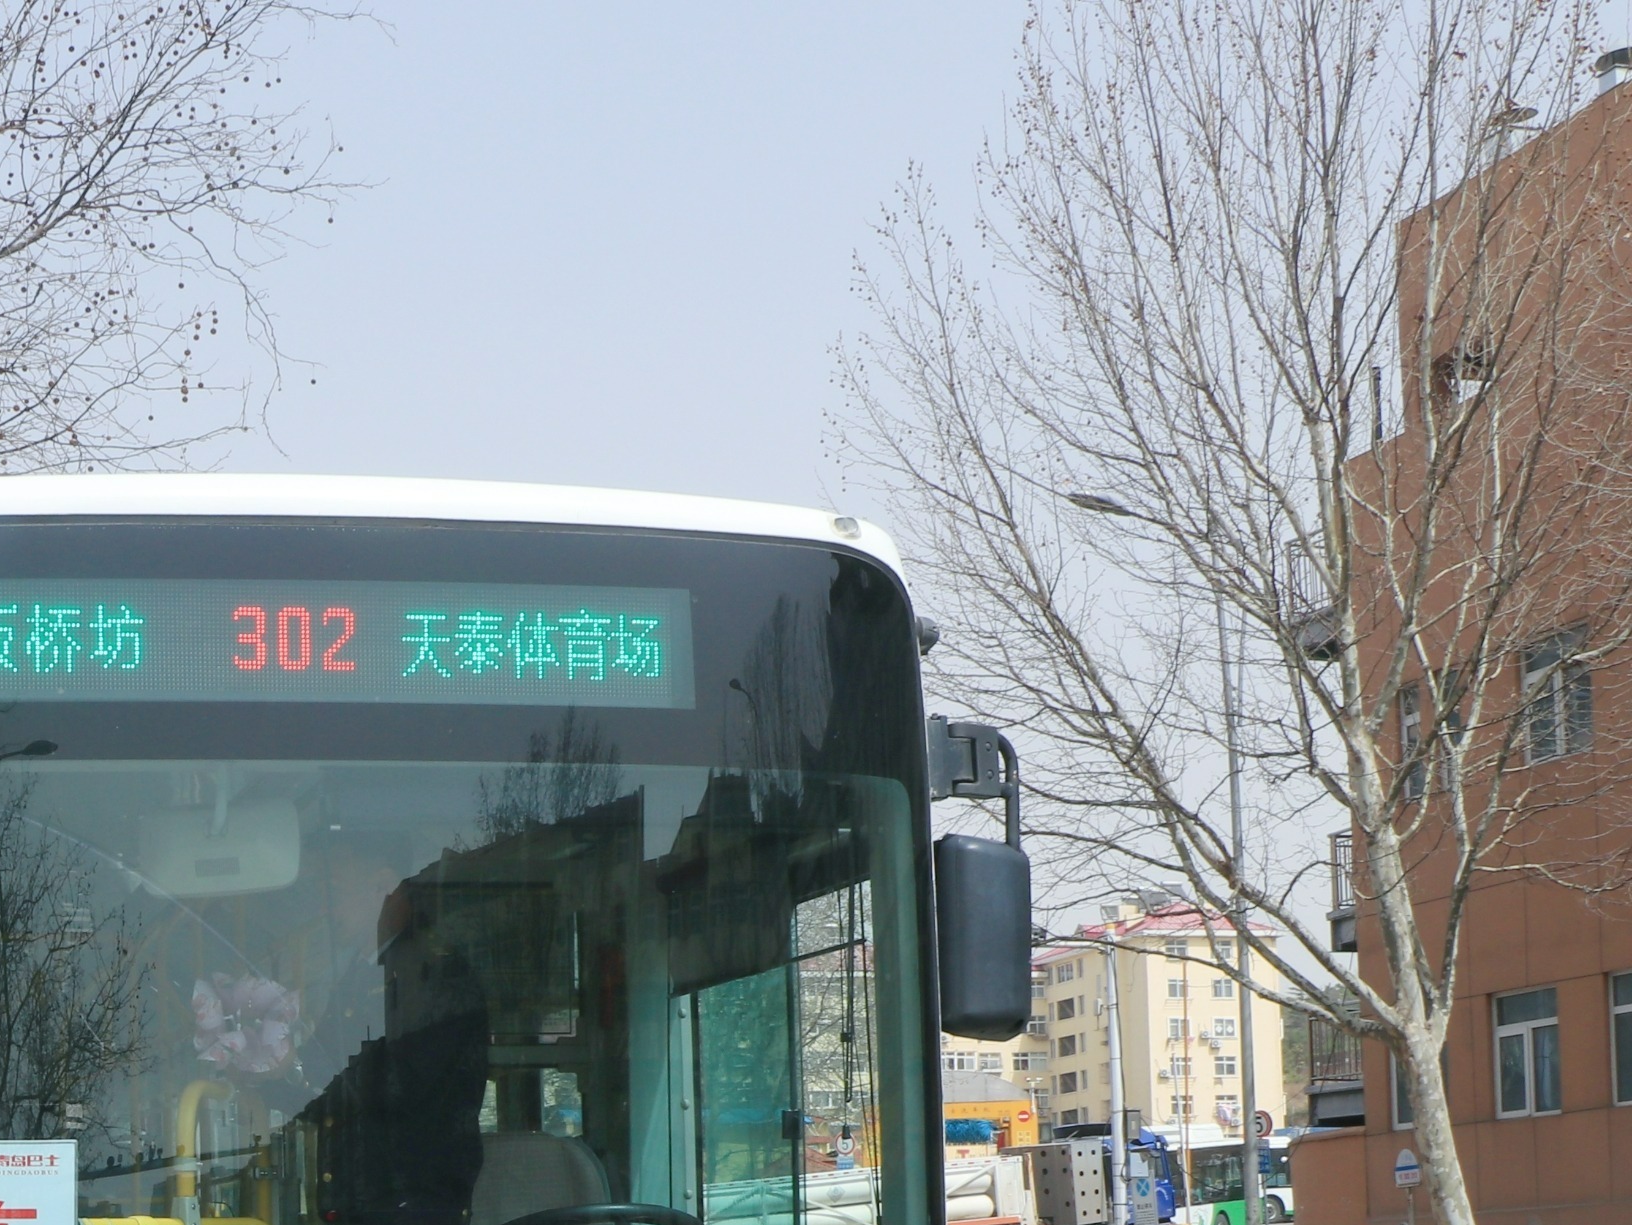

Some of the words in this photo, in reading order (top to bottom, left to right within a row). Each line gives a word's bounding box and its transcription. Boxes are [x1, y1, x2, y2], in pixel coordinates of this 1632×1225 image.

[231, 605, 356, 672] 302
[401, 608, 662, 682] 天泰体育场
